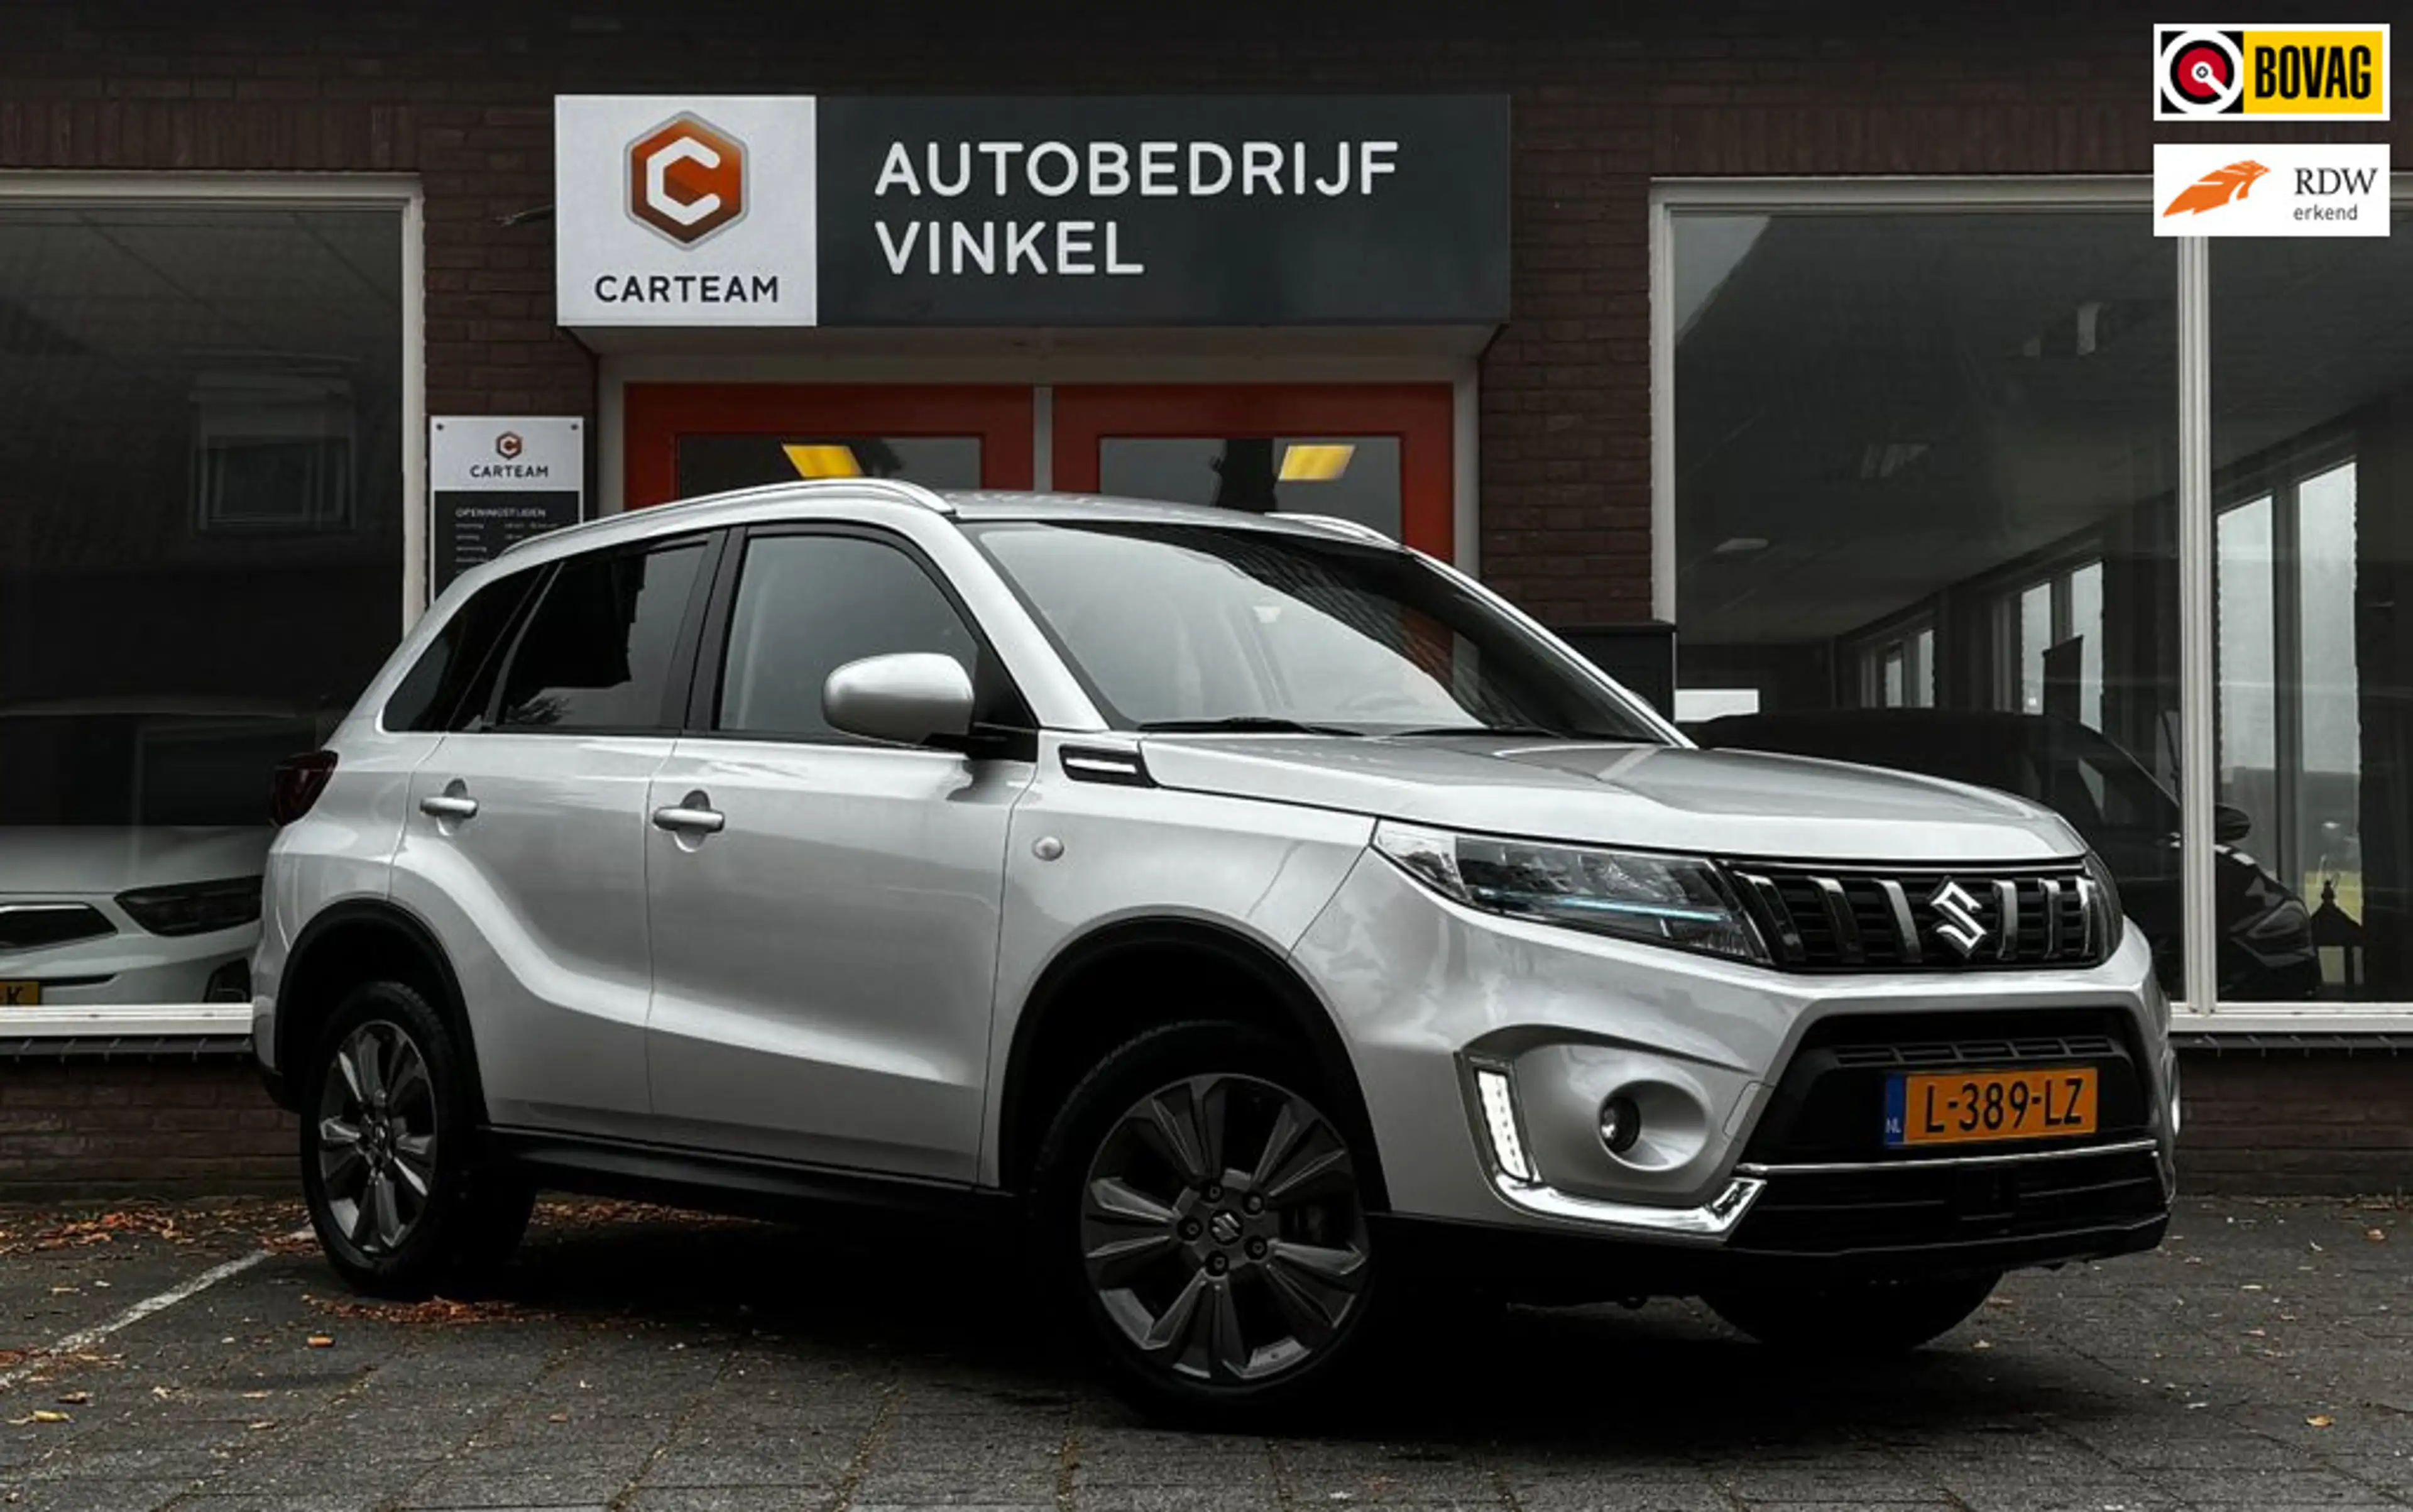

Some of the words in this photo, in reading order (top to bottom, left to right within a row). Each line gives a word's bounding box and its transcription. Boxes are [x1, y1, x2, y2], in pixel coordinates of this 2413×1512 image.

[875, 141, 1399, 197] AUTOBEDRIJF
[875, 221, 1144, 275] VINKEL
[594, 275, 779, 304] CARTEAM
[469, 464, 549, 478] CARTEAM
[1924, 1078, 2084, 1134] L-389-LZ
